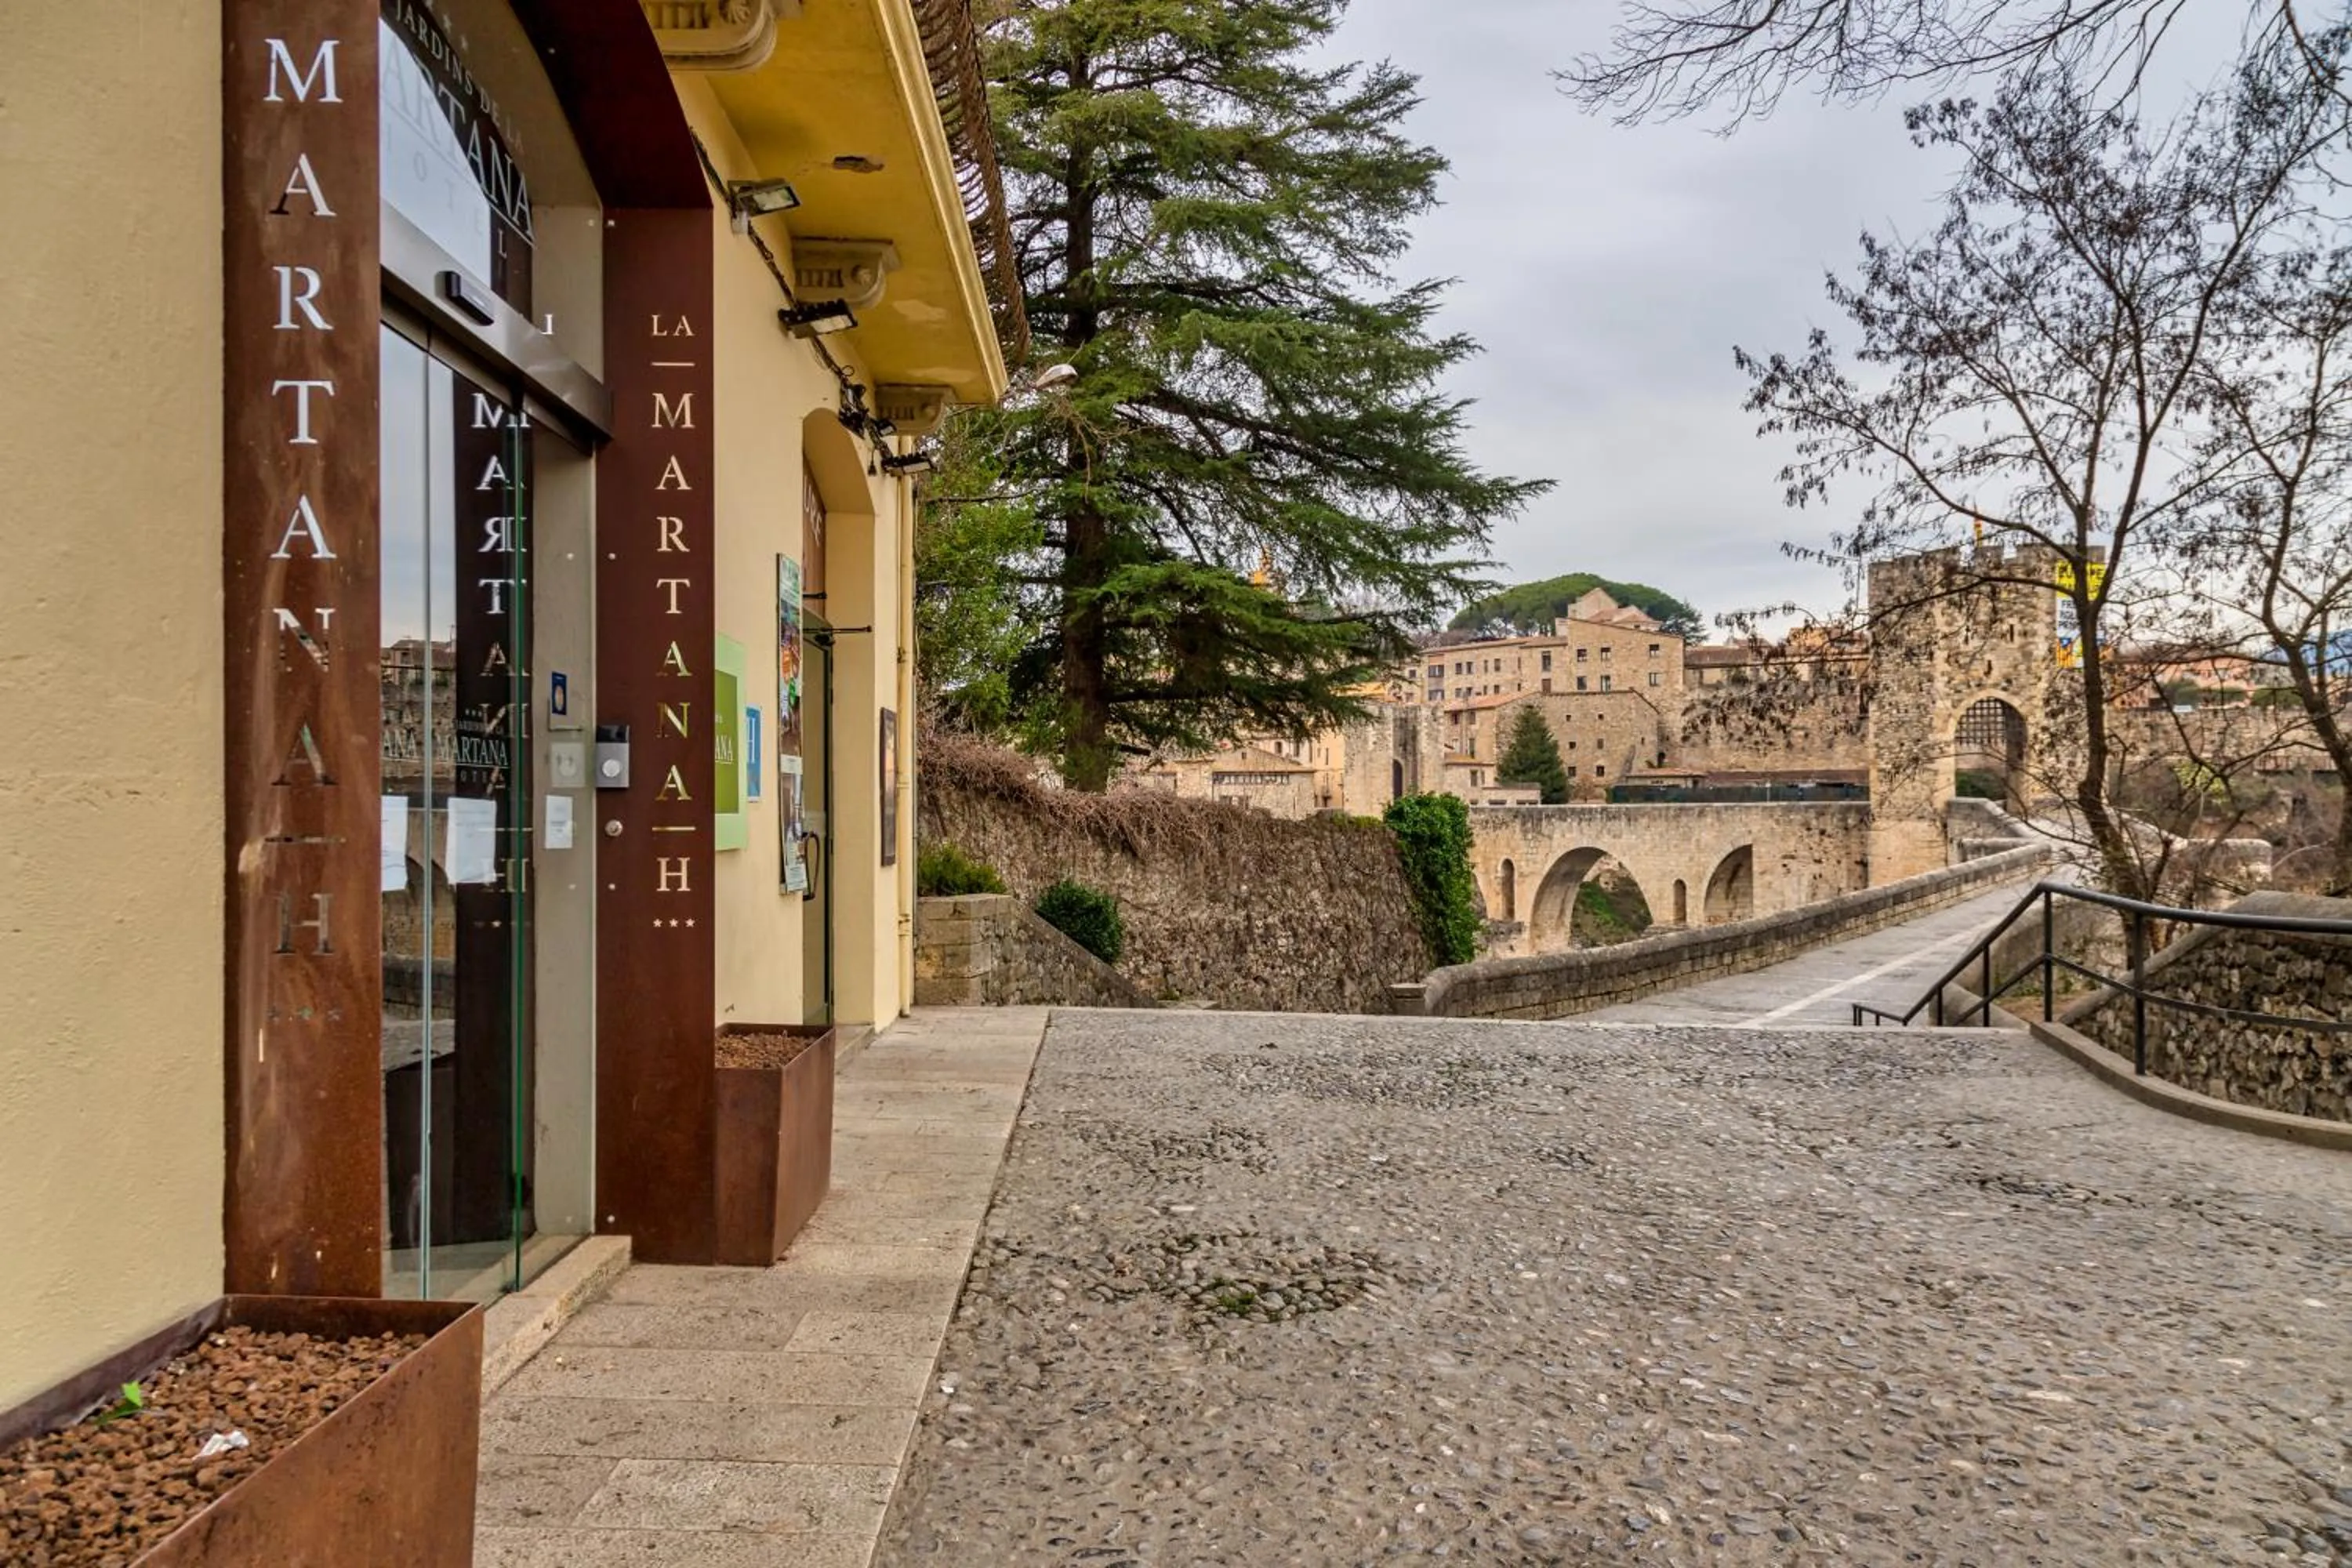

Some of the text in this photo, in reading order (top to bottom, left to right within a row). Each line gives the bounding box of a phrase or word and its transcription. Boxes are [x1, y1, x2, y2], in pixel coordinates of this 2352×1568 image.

[263, 38, 343, 787] MARTANA
[652, 314, 695, 336] LA
[652, 392, 696, 801] MARTANA
[657, 857, 691, 893] H
